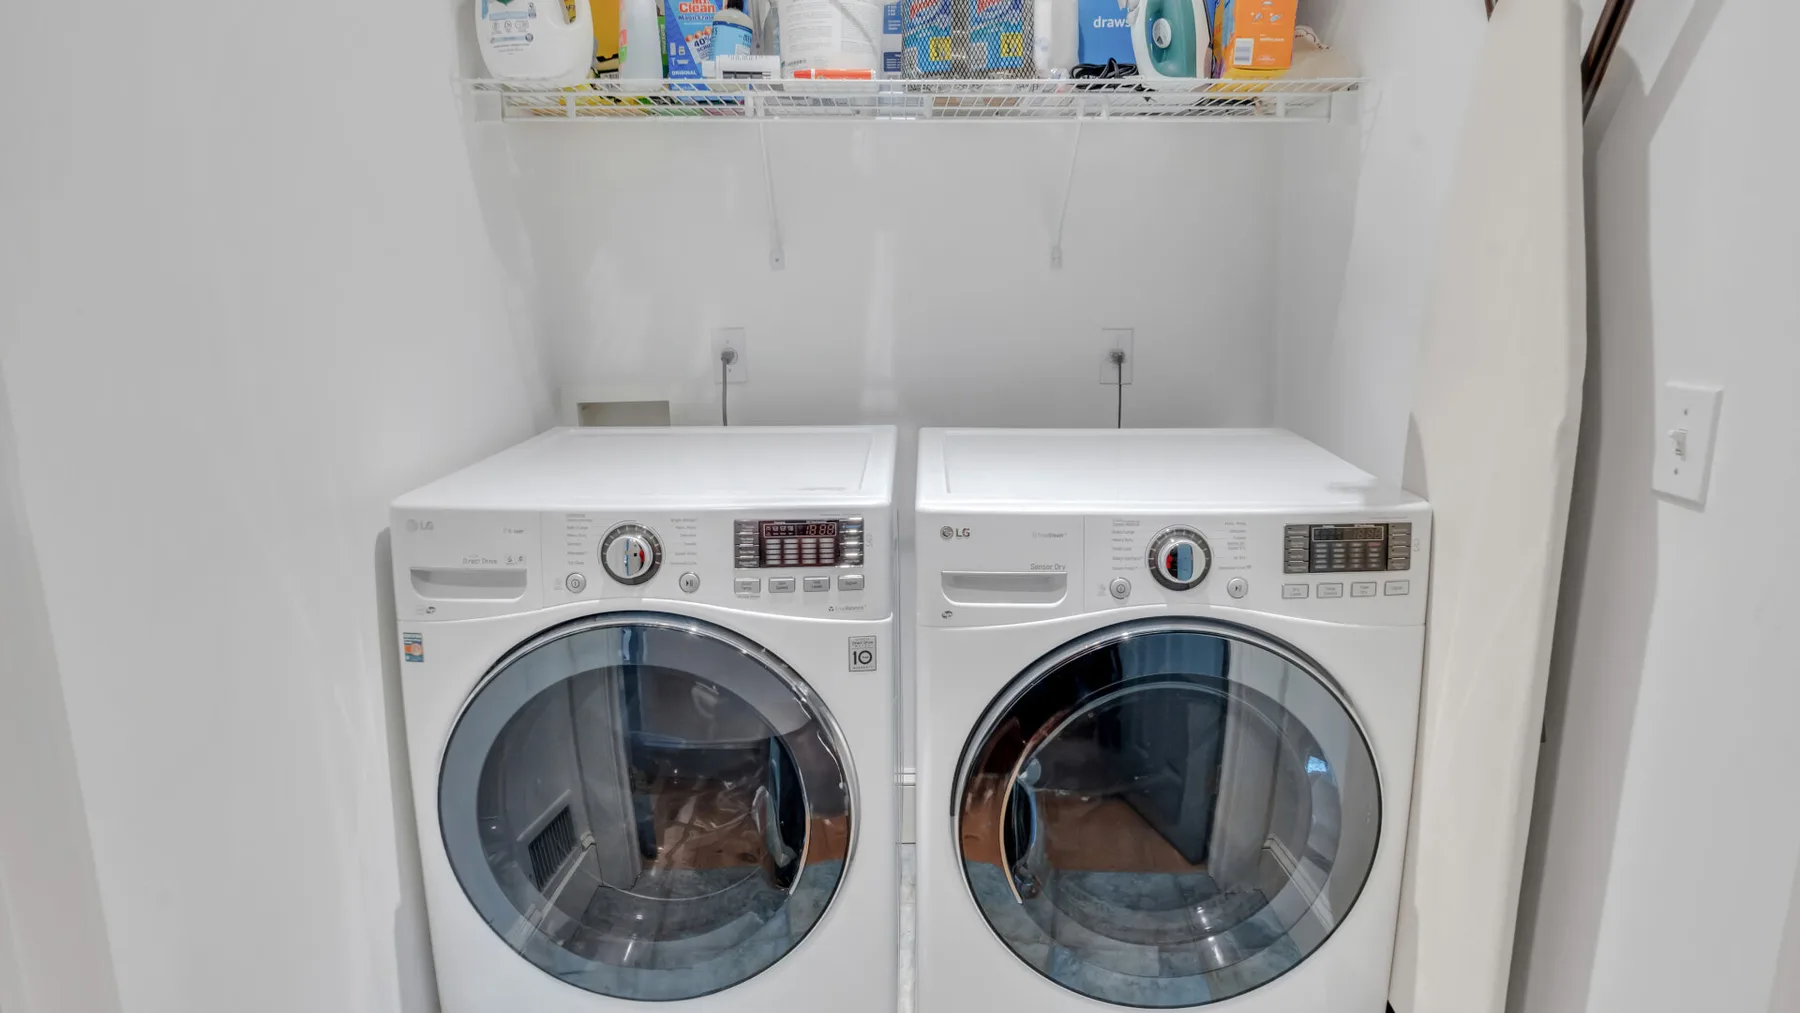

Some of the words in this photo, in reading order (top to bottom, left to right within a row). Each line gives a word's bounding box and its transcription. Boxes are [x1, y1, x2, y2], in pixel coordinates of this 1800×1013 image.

[679, 2, 715, 13] Clean
[1093, 16, 1131, 28] draws
[420, 520, 434, 531] LG
[955, 527, 971, 538] LG
[1054, 563, 1066, 571] Dry
[853, 650, 872, 665] 10
